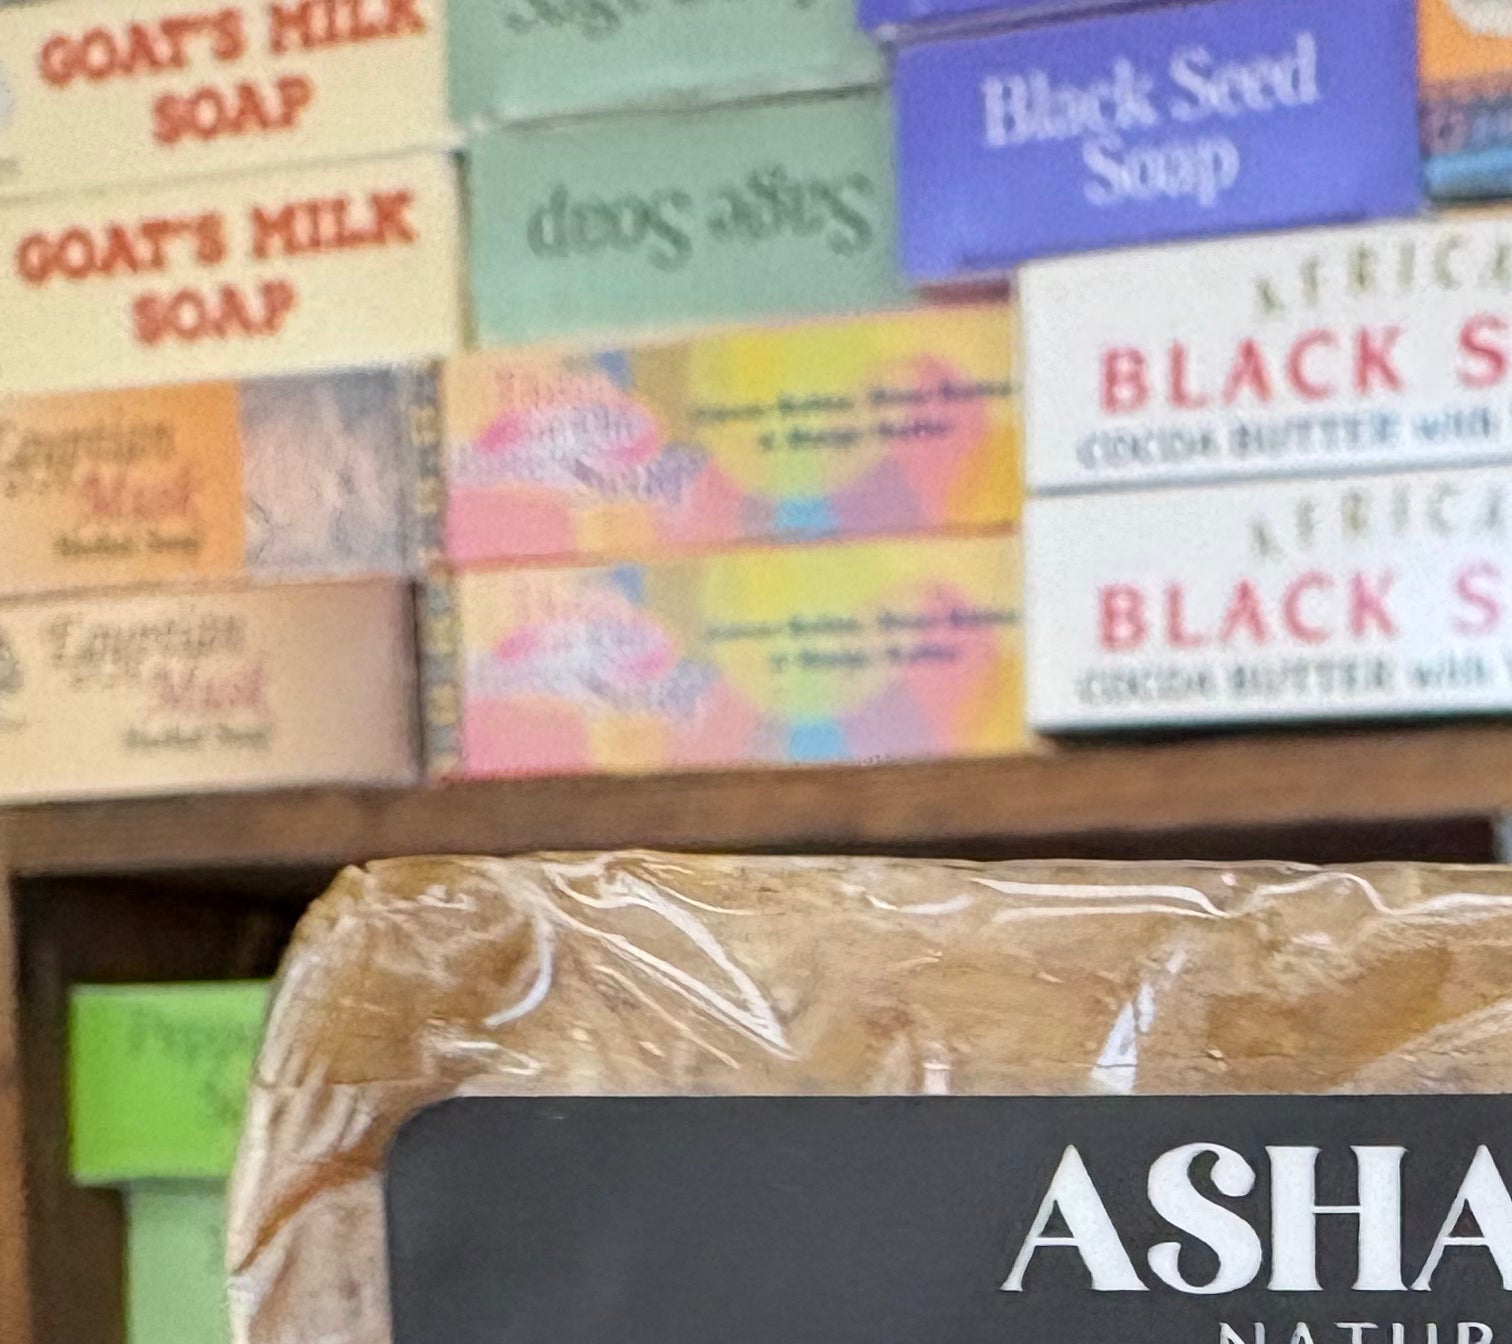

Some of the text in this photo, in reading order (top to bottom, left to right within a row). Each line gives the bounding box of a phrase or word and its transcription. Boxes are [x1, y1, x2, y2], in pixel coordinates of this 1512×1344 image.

[152, 74, 315, 147] SOAP
[979, 32, 1321, 148] Black Seed
[1080, 127, 1241, 206] Soap
[15, 188, 420, 285] GOAT'S MILK
[130, 281, 297, 346] SOAP
[1098, 325, 1403, 414] BLACK
[1096, 570, 1400, 651] BLACK
